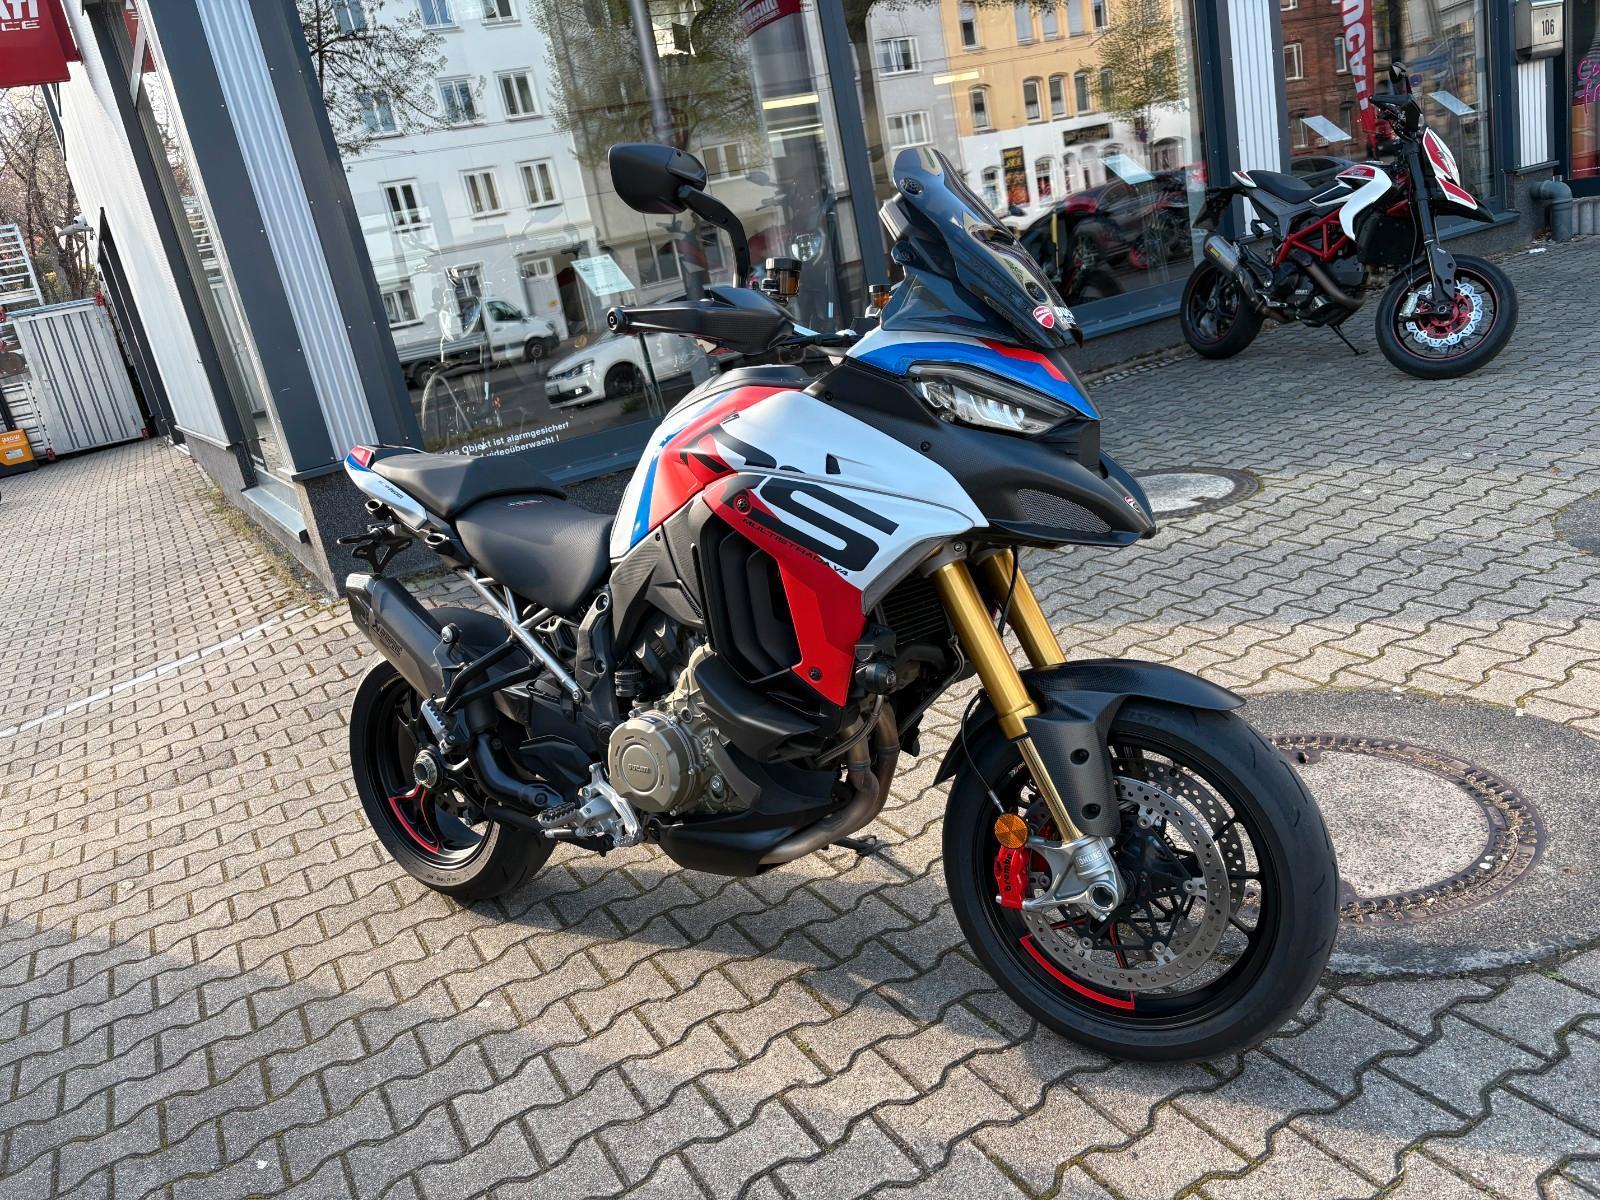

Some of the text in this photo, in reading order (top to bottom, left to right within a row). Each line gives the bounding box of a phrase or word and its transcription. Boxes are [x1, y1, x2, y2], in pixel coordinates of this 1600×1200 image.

[1541, 19, 1555, 36] 106
[461, 441, 492, 455] Objekt
[493, 437, 505, 447] ist
[506, 421, 569, 443] alarmgesichert
[743, 518, 849, 577] MULTISTRADA V4
[1003, 853, 1013, 892] brembo
